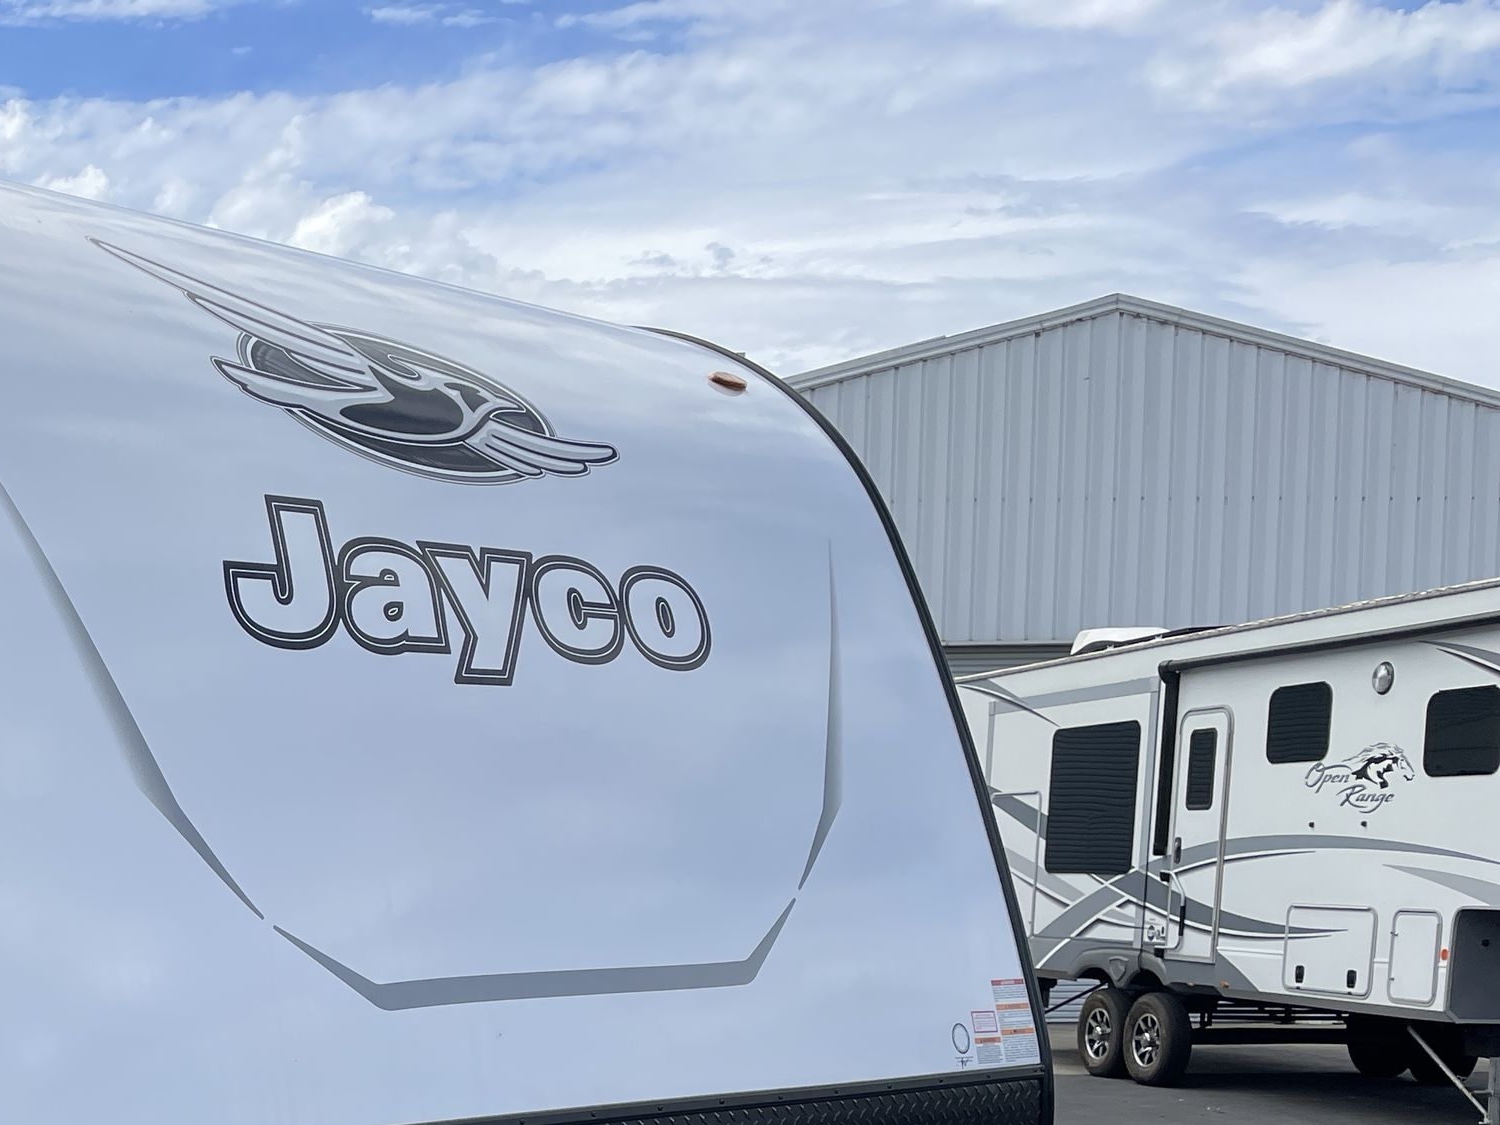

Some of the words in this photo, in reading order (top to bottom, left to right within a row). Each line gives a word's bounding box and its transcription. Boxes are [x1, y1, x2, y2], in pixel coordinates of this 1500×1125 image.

[222, 493, 713, 687] Jayco
[1304, 762, 1353, 794] Open
[1336, 784, 1395, 814] Range
